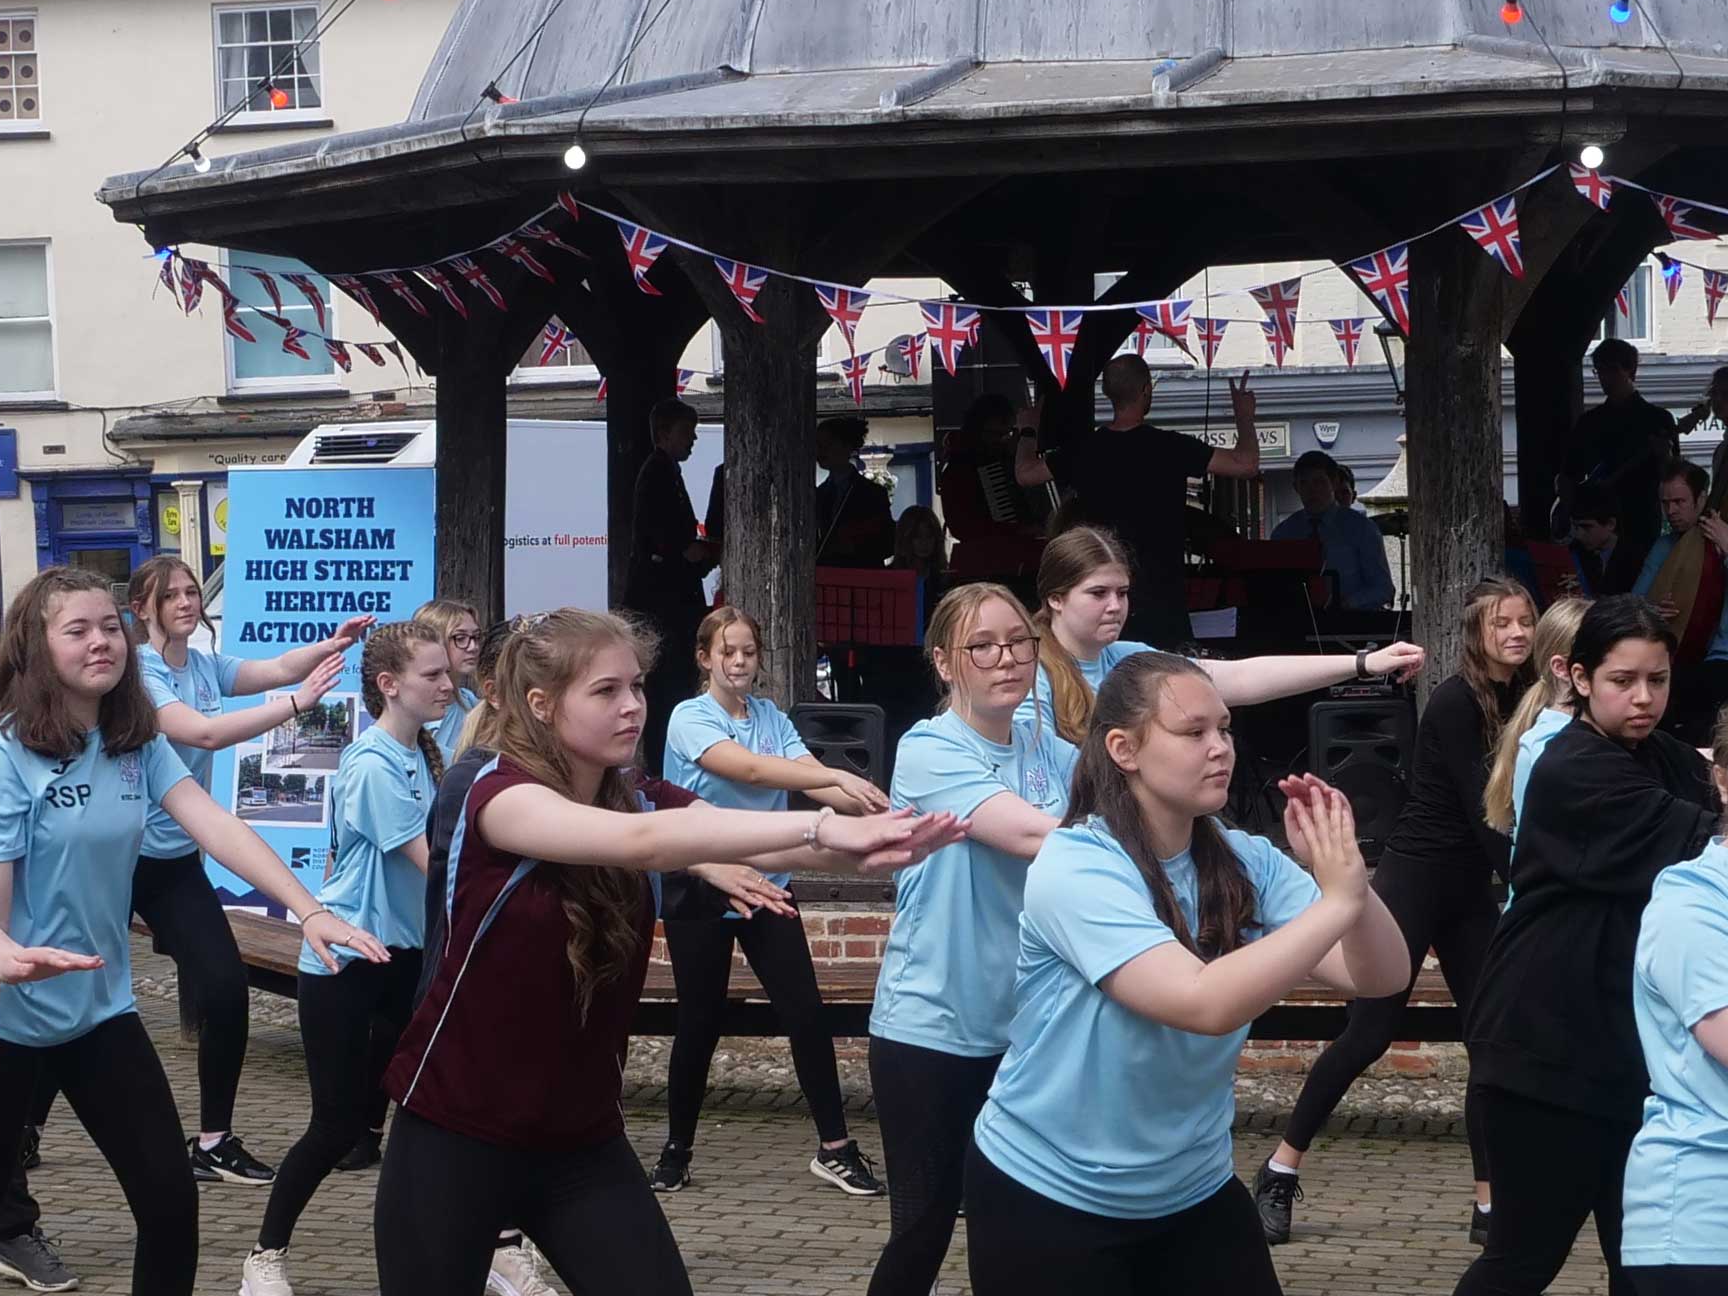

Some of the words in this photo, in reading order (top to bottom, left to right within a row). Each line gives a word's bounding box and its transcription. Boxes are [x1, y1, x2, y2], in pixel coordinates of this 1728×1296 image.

[1232, 430, 1278, 445] NWS
[285, 497, 375, 519] NORTH
[264, 529, 395, 550] WALSHAM
[542, 536, 552, 546] at
[554, 534, 570, 546] full
[245, 560, 308, 581] HIGH
[314, 559, 413, 581] STREET
[265, 591, 391, 612] HERITAGE
[239, 621, 338, 643] ACTION
